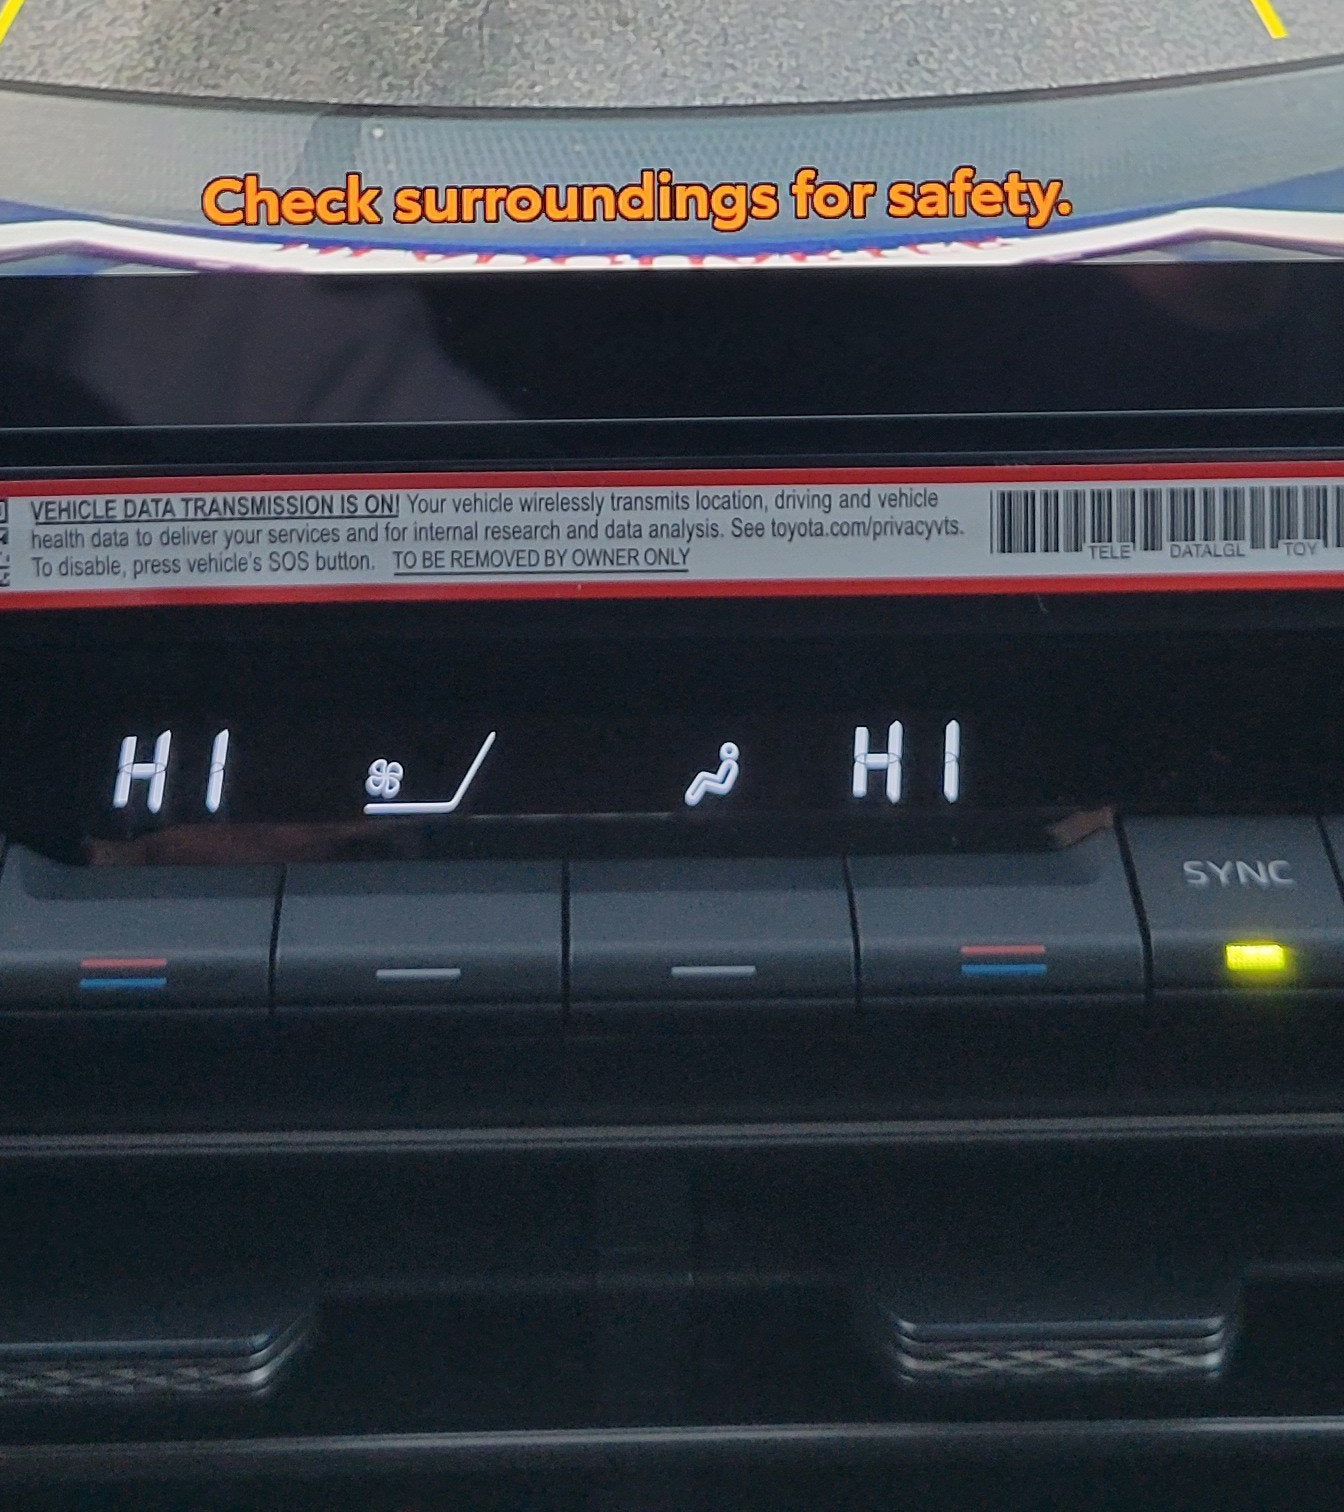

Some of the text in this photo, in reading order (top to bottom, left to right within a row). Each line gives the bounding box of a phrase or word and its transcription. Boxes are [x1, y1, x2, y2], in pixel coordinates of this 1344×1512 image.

[202, 165, 1074, 232] Check surroundings for safety.
[31, 488, 938, 521] VEHICLE DATA TRANSMISSION IS ON! Your vehicle wirelessly transmits location, driving and vehicle
[31, 516, 964, 550] health data to deliver your services and for internal research and data analysis. See toyota.com/privacyvts.
[32, 550, 375, 579] To disable, press vehicle's SOS button.
[393, 547, 690, 569] TO BE REMOVED BY OWNER ONLY
[1088, 541, 1317, 560] TELE DATALGL TOY
[1183, 858, 1295, 887] SYNC
